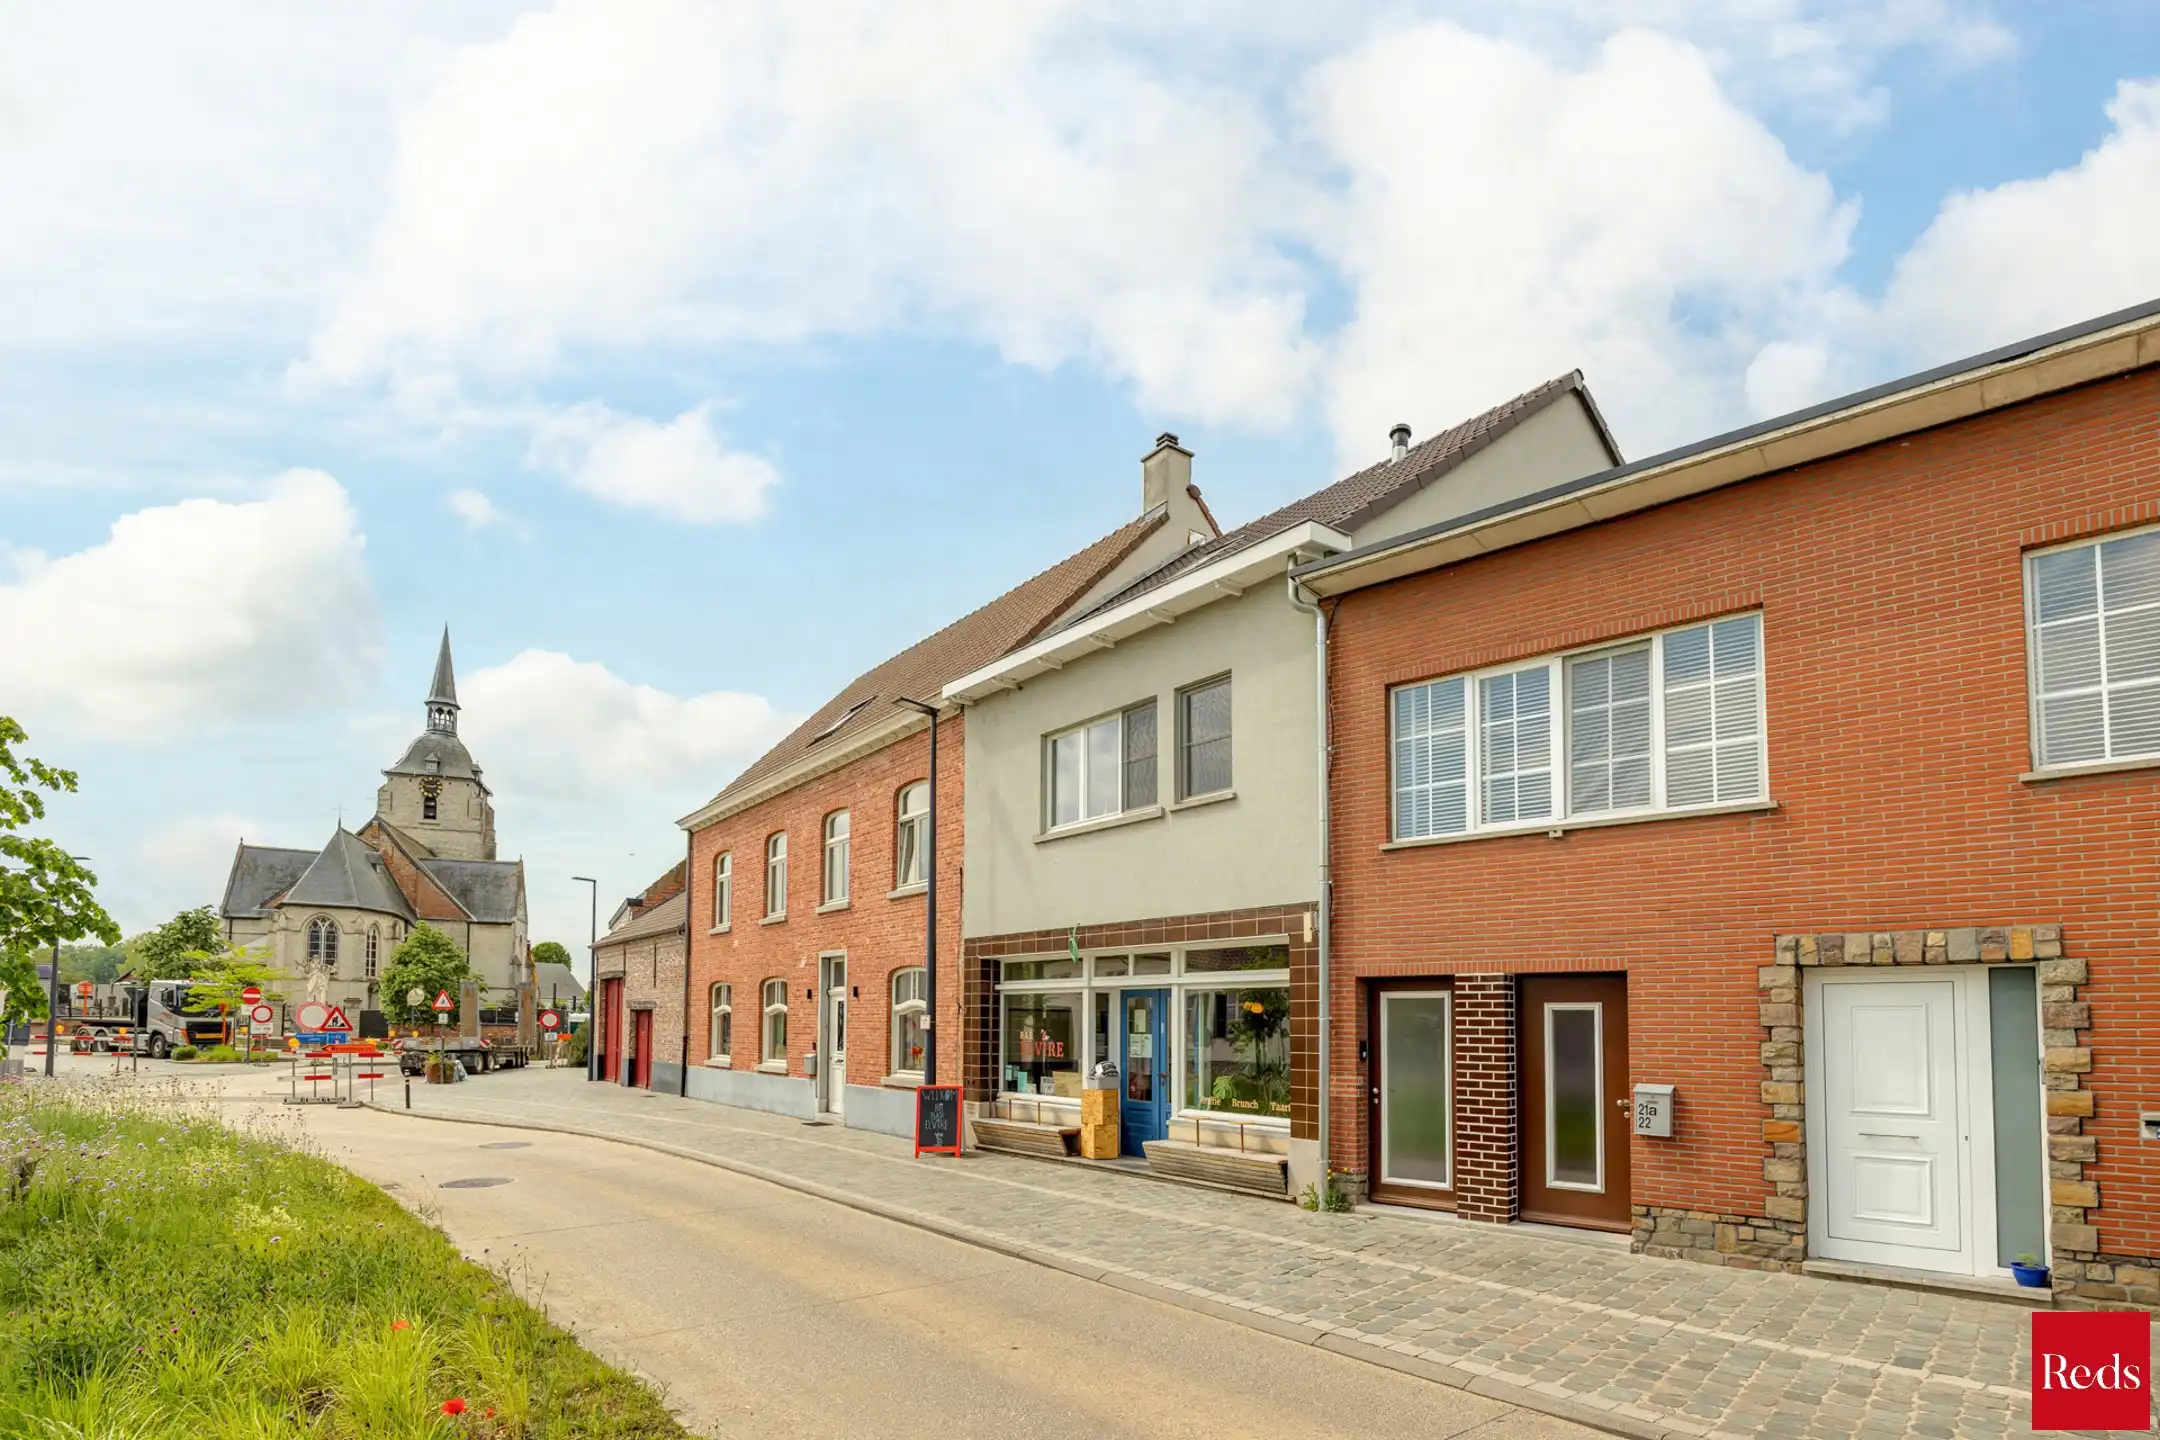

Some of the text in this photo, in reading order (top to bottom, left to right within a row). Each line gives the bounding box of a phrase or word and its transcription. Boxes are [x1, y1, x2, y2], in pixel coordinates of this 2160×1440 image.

[1231, 1098, 1259, 1109] Brunch
[1638, 1103, 1657, 1116] 21a
[1638, 1116, 1651, 1129] 22
